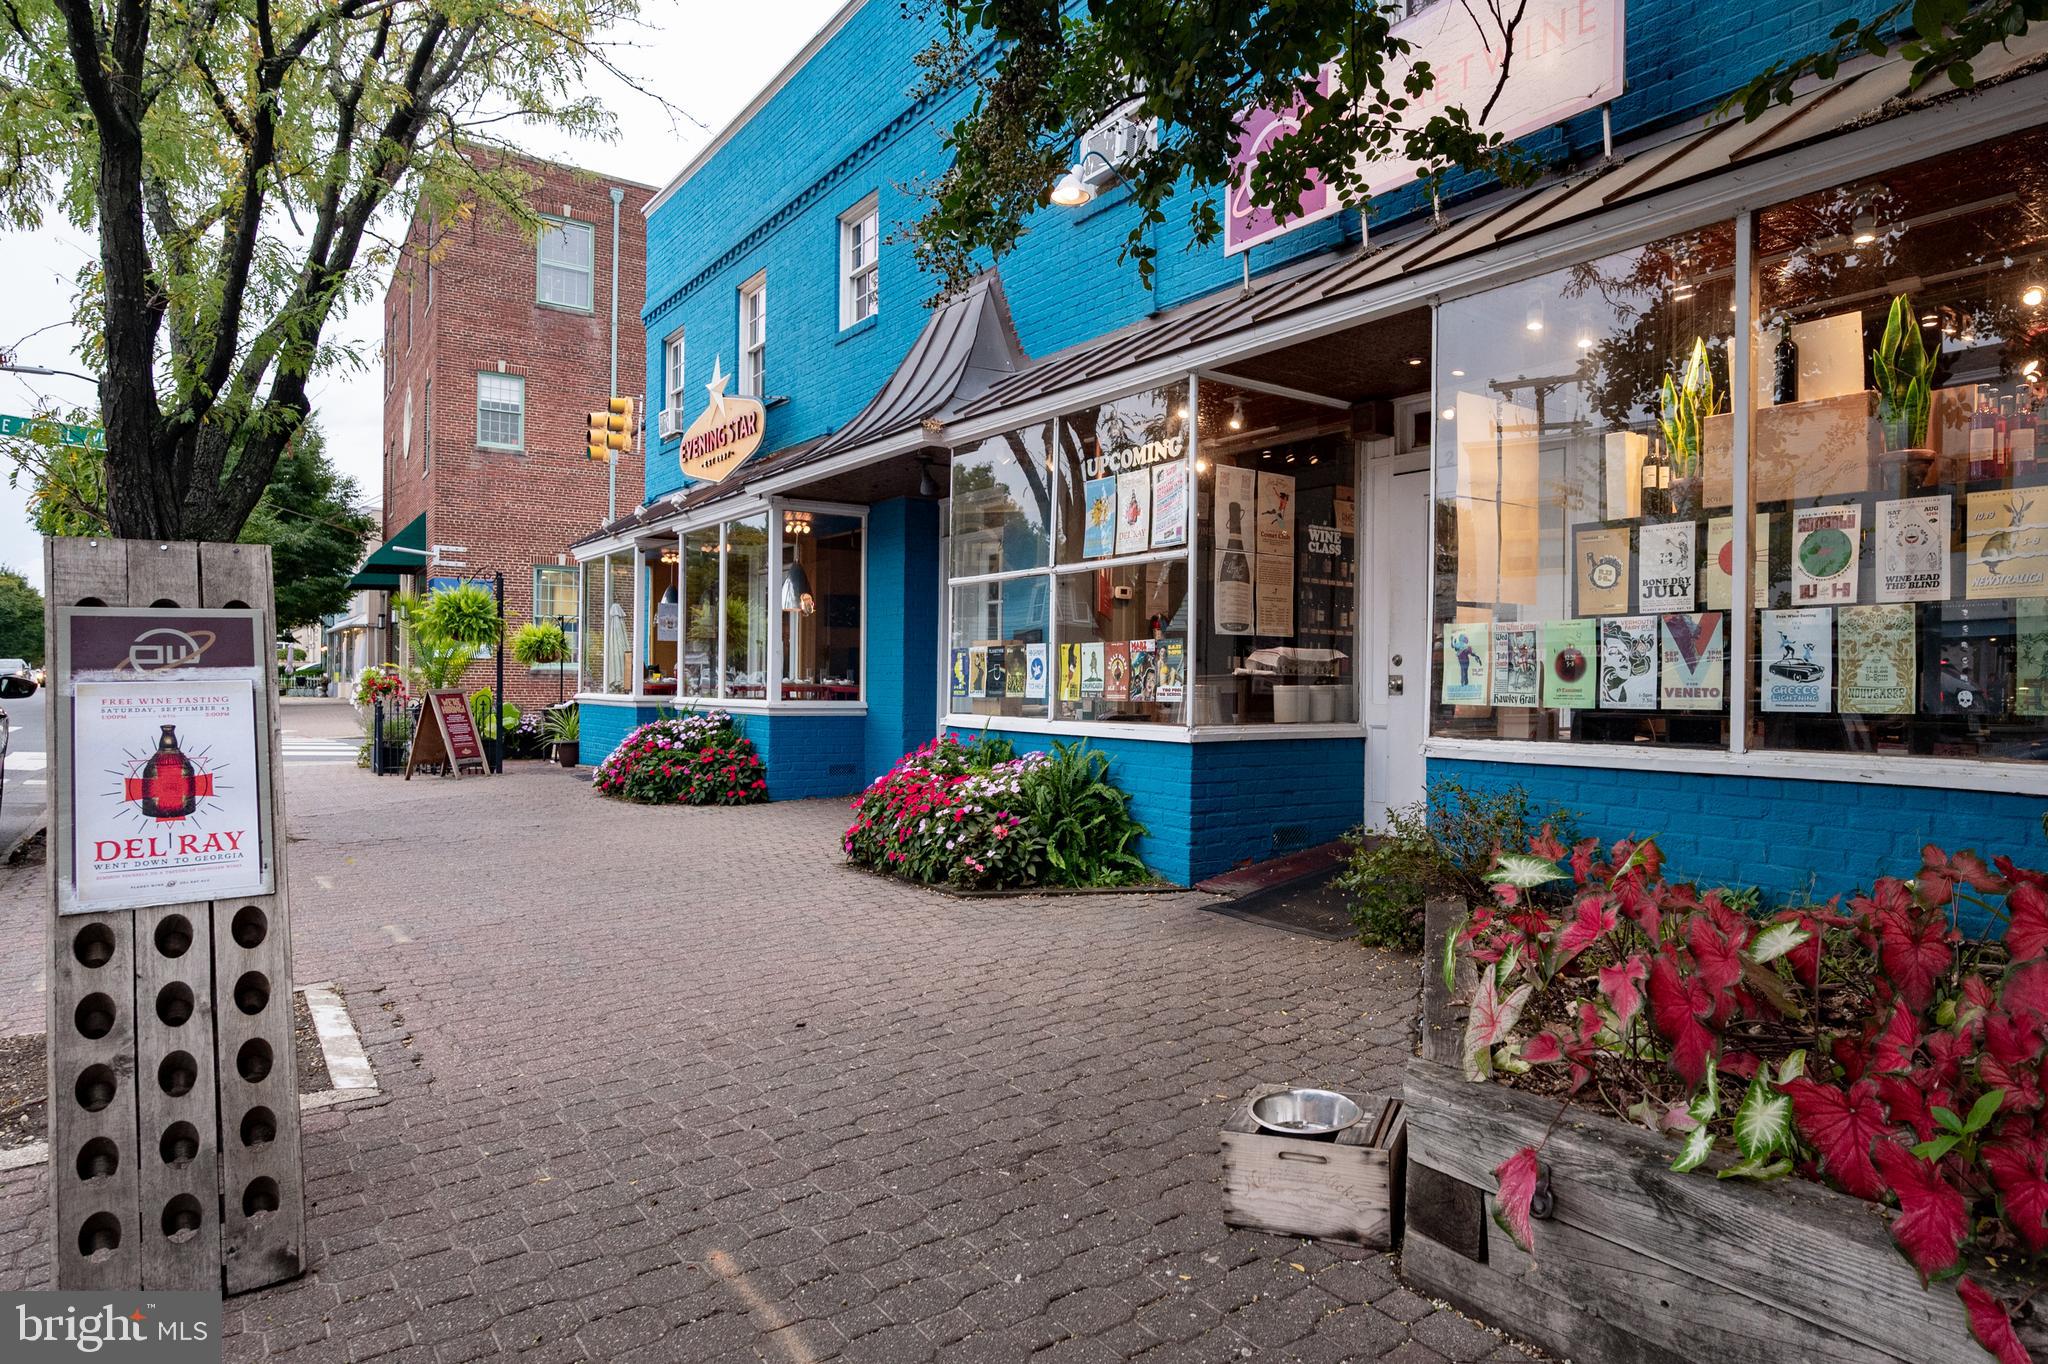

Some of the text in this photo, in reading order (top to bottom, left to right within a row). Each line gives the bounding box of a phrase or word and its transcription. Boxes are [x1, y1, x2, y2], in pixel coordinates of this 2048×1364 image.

[2, 419, 11, 432] E
[681, 411, 758, 464] EVENING STAR
[1086, 436, 1183, 477] UPCOMING
[1309, 529, 1342, 544] WINE
[1308, 541, 1342, 556] CLASS
[1642, 576, 1692, 587] BONE DRY
[1885, 573, 1940, 583] WINE LEAD
[1642, 583, 1692, 598] JULY
[1885, 580, 1940, 590] THE BLIND
[1664, 656, 1679, 664] 3RD
[1664, 687, 1721, 698] VENETO
[1771, 685, 1820, 695] GREECE
[101, 695, 230, 706] FREE WINE TASTING
[1771, 694, 1819, 703] LIGHTNING
[101, 706, 156, 714] SATURDAY,
[161, 705, 216, 713] SEPTEMBER
[94, 830, 245, 862] DEL RAY
[94, 852, 245, 871] WENT DOWN TO GEORGIA
